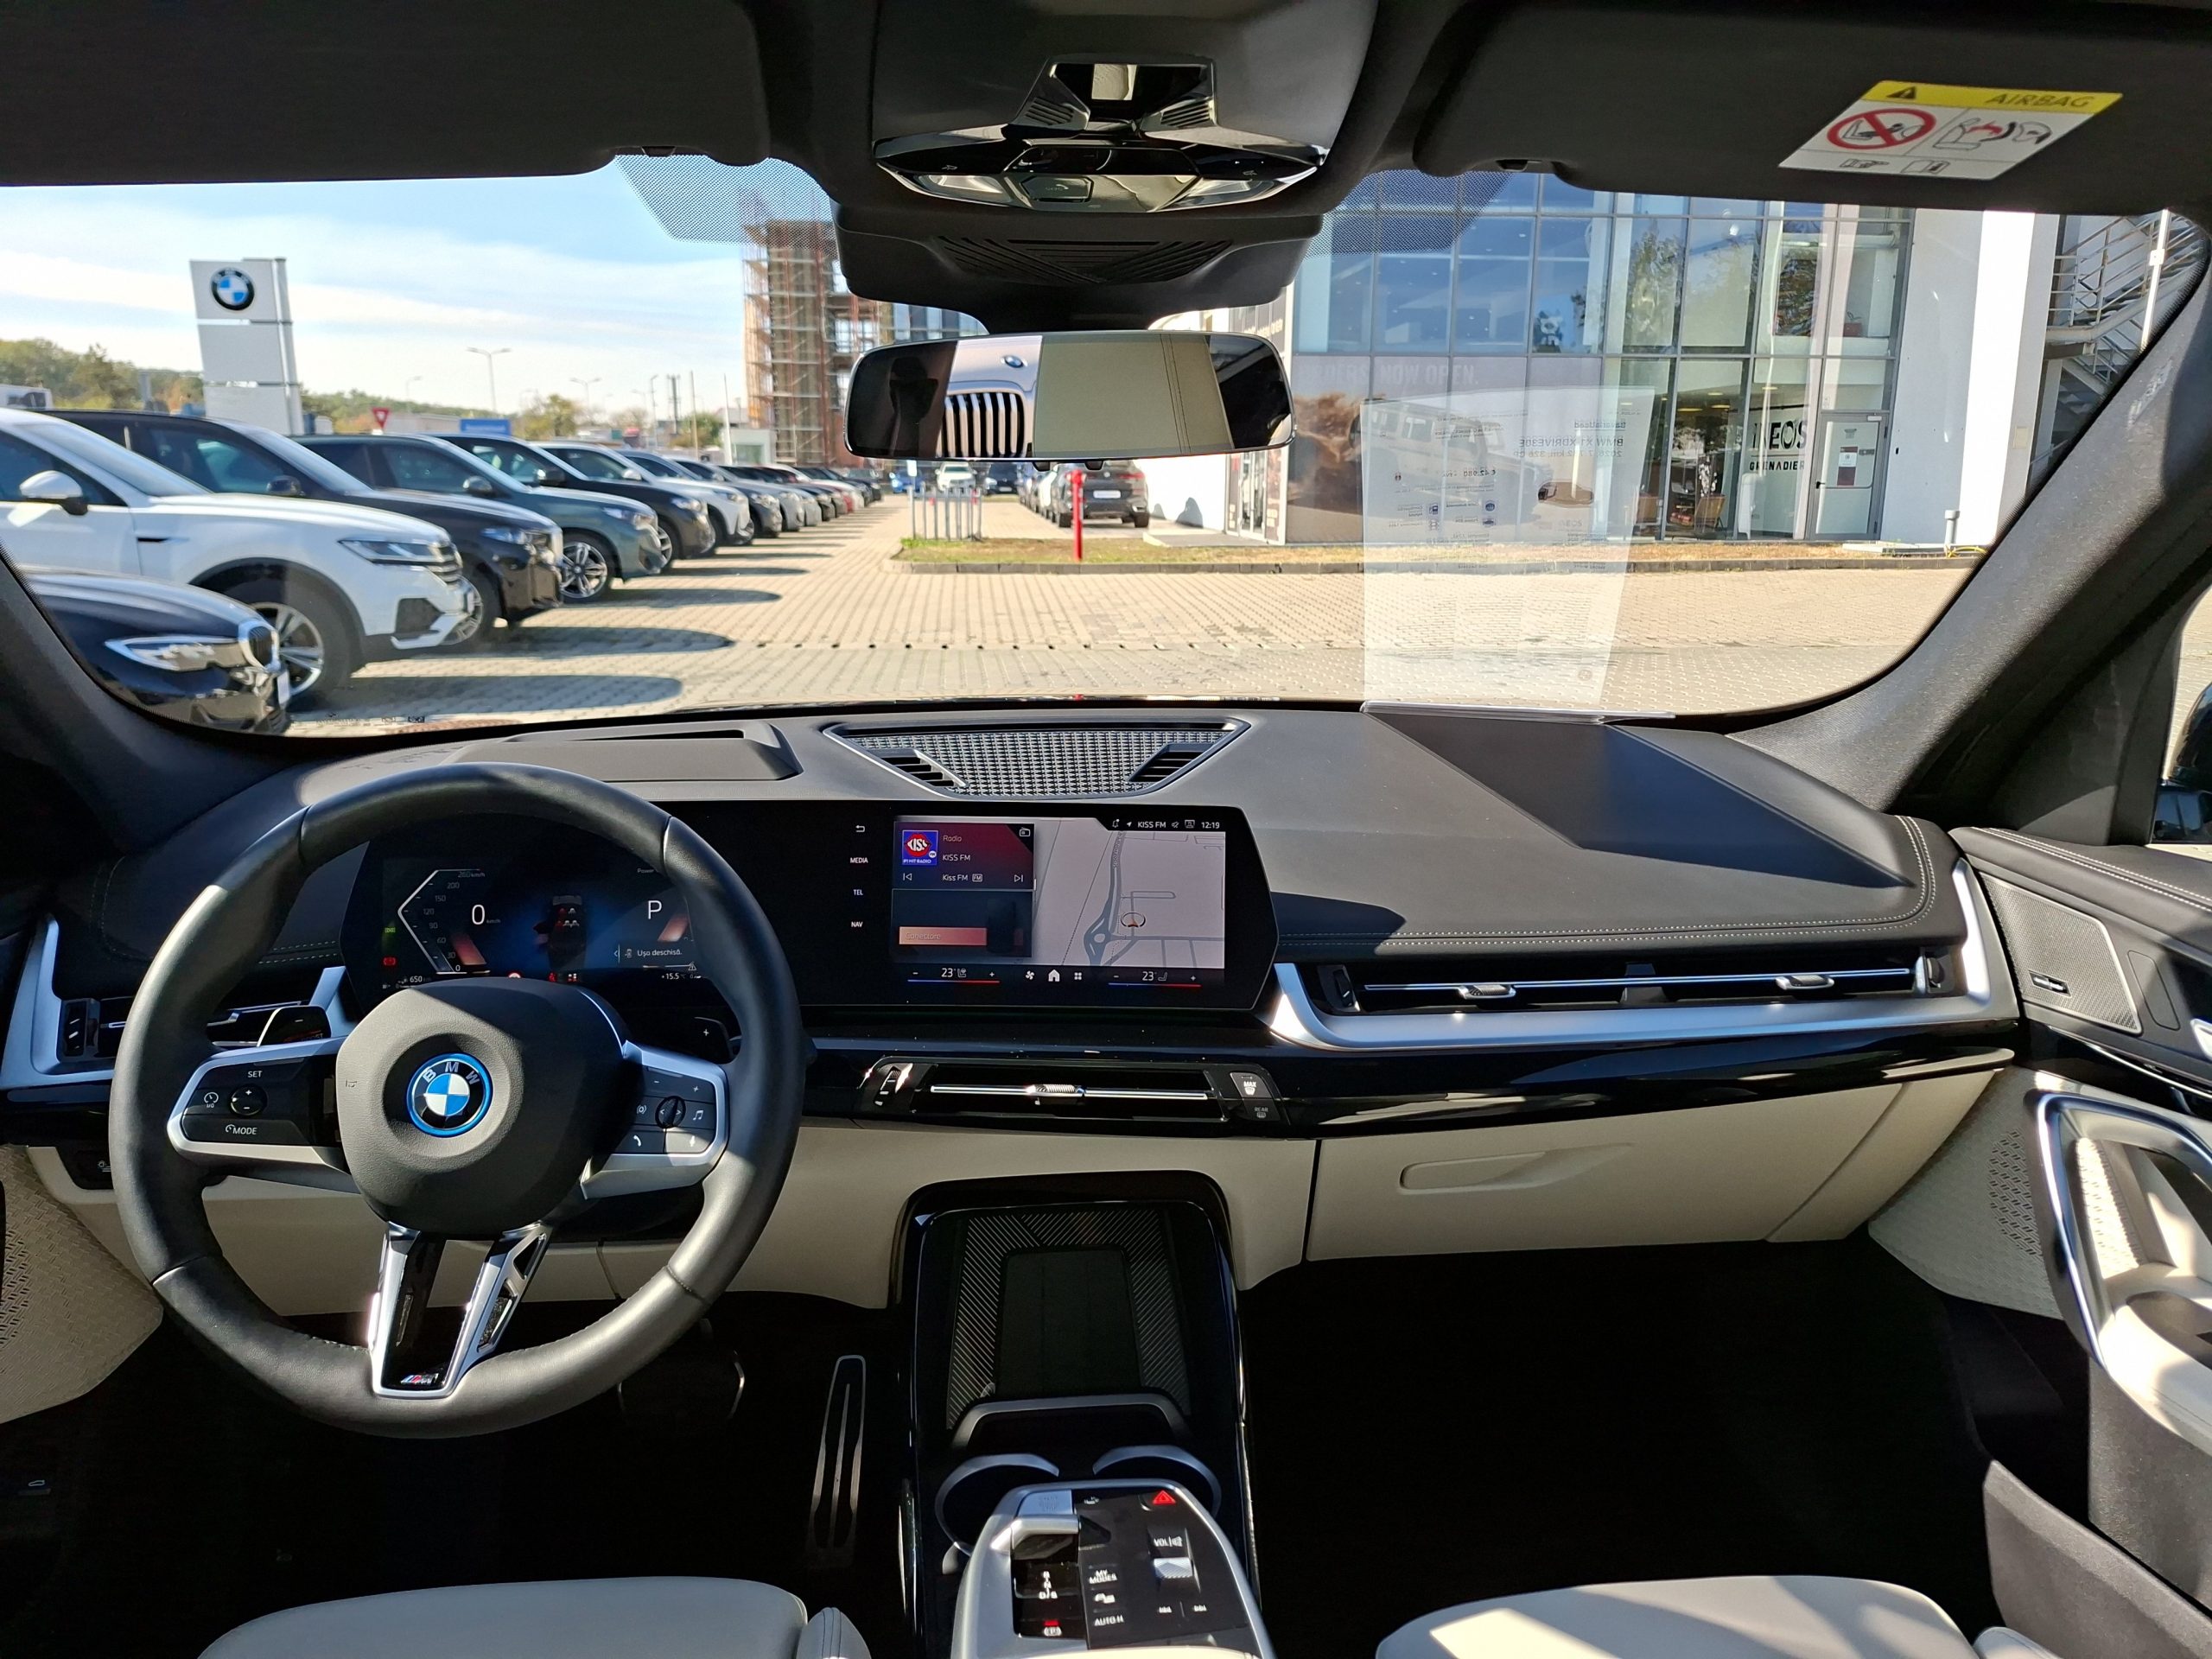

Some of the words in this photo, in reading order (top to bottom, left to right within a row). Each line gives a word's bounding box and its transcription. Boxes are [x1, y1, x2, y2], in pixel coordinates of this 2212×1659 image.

[1985, 93, 2094, 108] AIRBAG
[471, 904, 486, 925] 0
[647, 899, 663, 920] P
[232, 1127, 257, 1135] MODE
[1154, 1538, 1169, 1547] VOL
